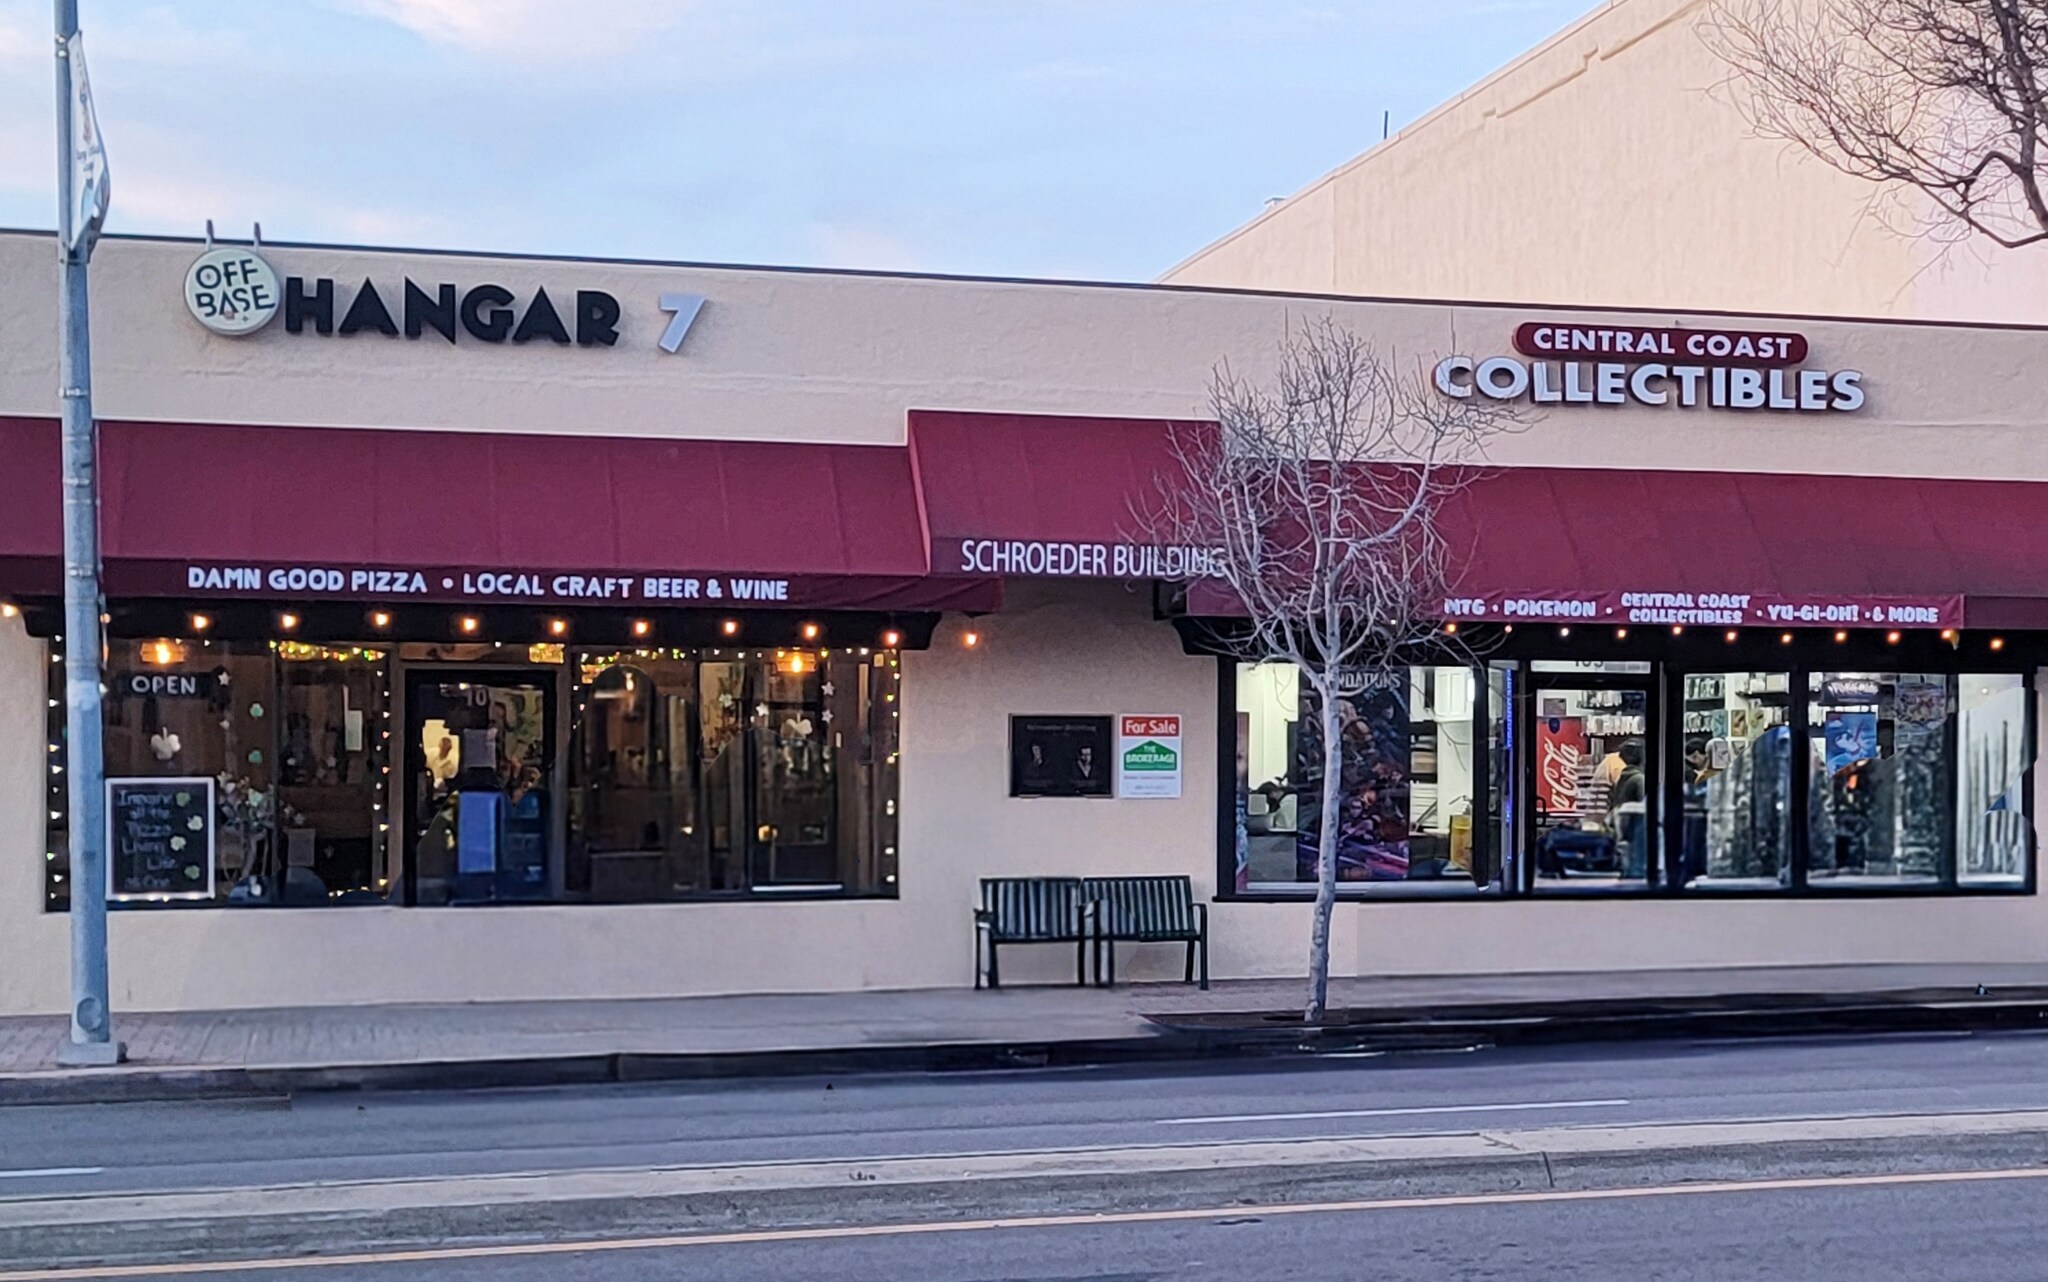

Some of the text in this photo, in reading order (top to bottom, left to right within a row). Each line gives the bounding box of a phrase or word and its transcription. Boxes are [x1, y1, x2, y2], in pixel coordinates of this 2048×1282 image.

[195, 258, 258, 290] OFF
[195, 284, 276, 318] BASE
[285, 276, 706, 353] HANGAR 7
[1532, 327, 1792, 359] CENTRAL COAST
[1434, 356, 1865, 411] COLLECTIBLES
[960, 539, 1227, 578] SCHROEDER BUILDING
[188, 566, 788, 600] DAMN GOOD PIZZA LOCAL CRAFT BEER & WINE
[1504, 599, 1596, 617] POKEMON
[1621, 592, 1751, 609] CENTRAL COAST
[1767, 604, 1860, 623] YU-GI-OH!
[1629, 608, 1743, 624] COLLECTIBLES
[1888, 607, 1939, 623] MORE
[131, 675, 196, 695] OPEN
[1125, 719, 1177, 734] For Sale
